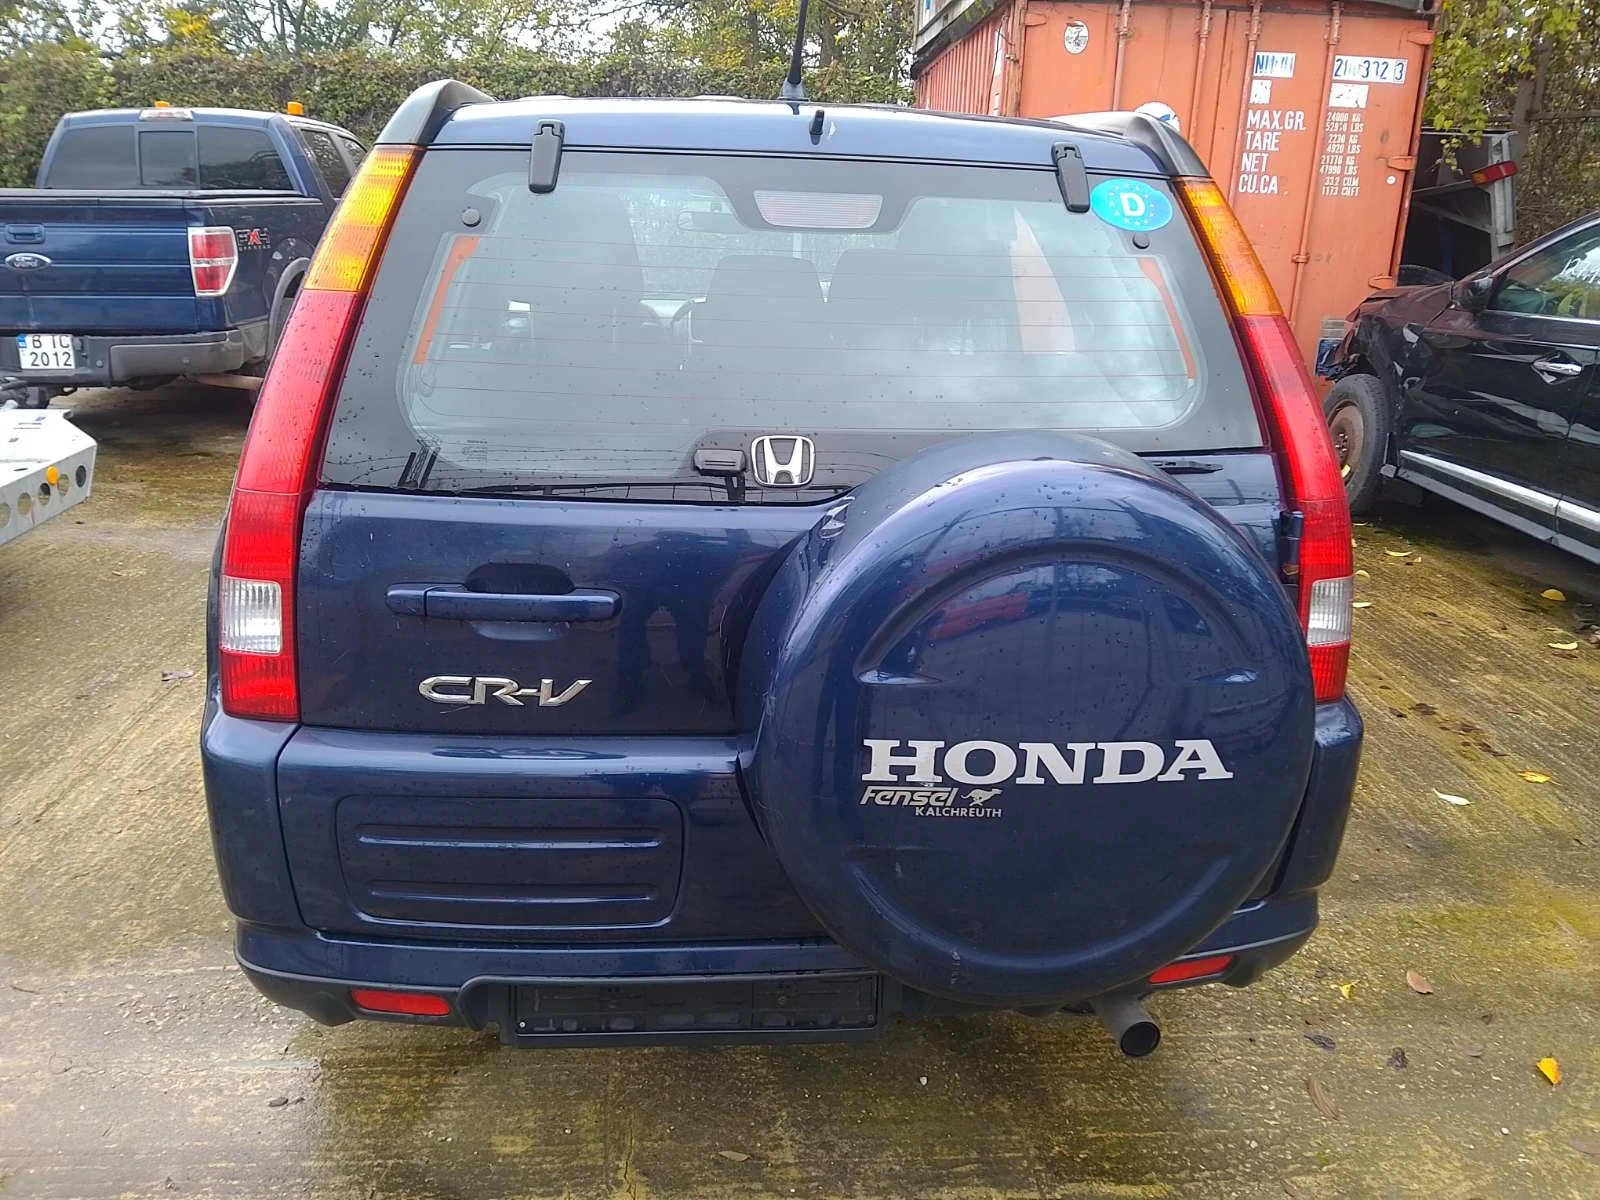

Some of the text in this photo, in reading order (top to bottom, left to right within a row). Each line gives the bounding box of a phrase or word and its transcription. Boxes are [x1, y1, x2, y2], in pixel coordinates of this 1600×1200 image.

[1350, 122, 1364, 133] LBS
[1245, 130, 1282, 151] TARE
[1327, 144, 1361, 154] 4920 LBS
[1240, 152, 1269, 172] NET
[1344, 165, 1359, 175] LBS
[1120, 192, 1146, 217] D
[31, 334, 42, 349] B
[30, 351, 72, 367] 2012
[418, 675, 593, 707] CR-V
[861, 738, 1234, 785] HONDA
[859, 785, 960, 807] Fensel
[914, 806, 1002, 818] KALCHREUTH
